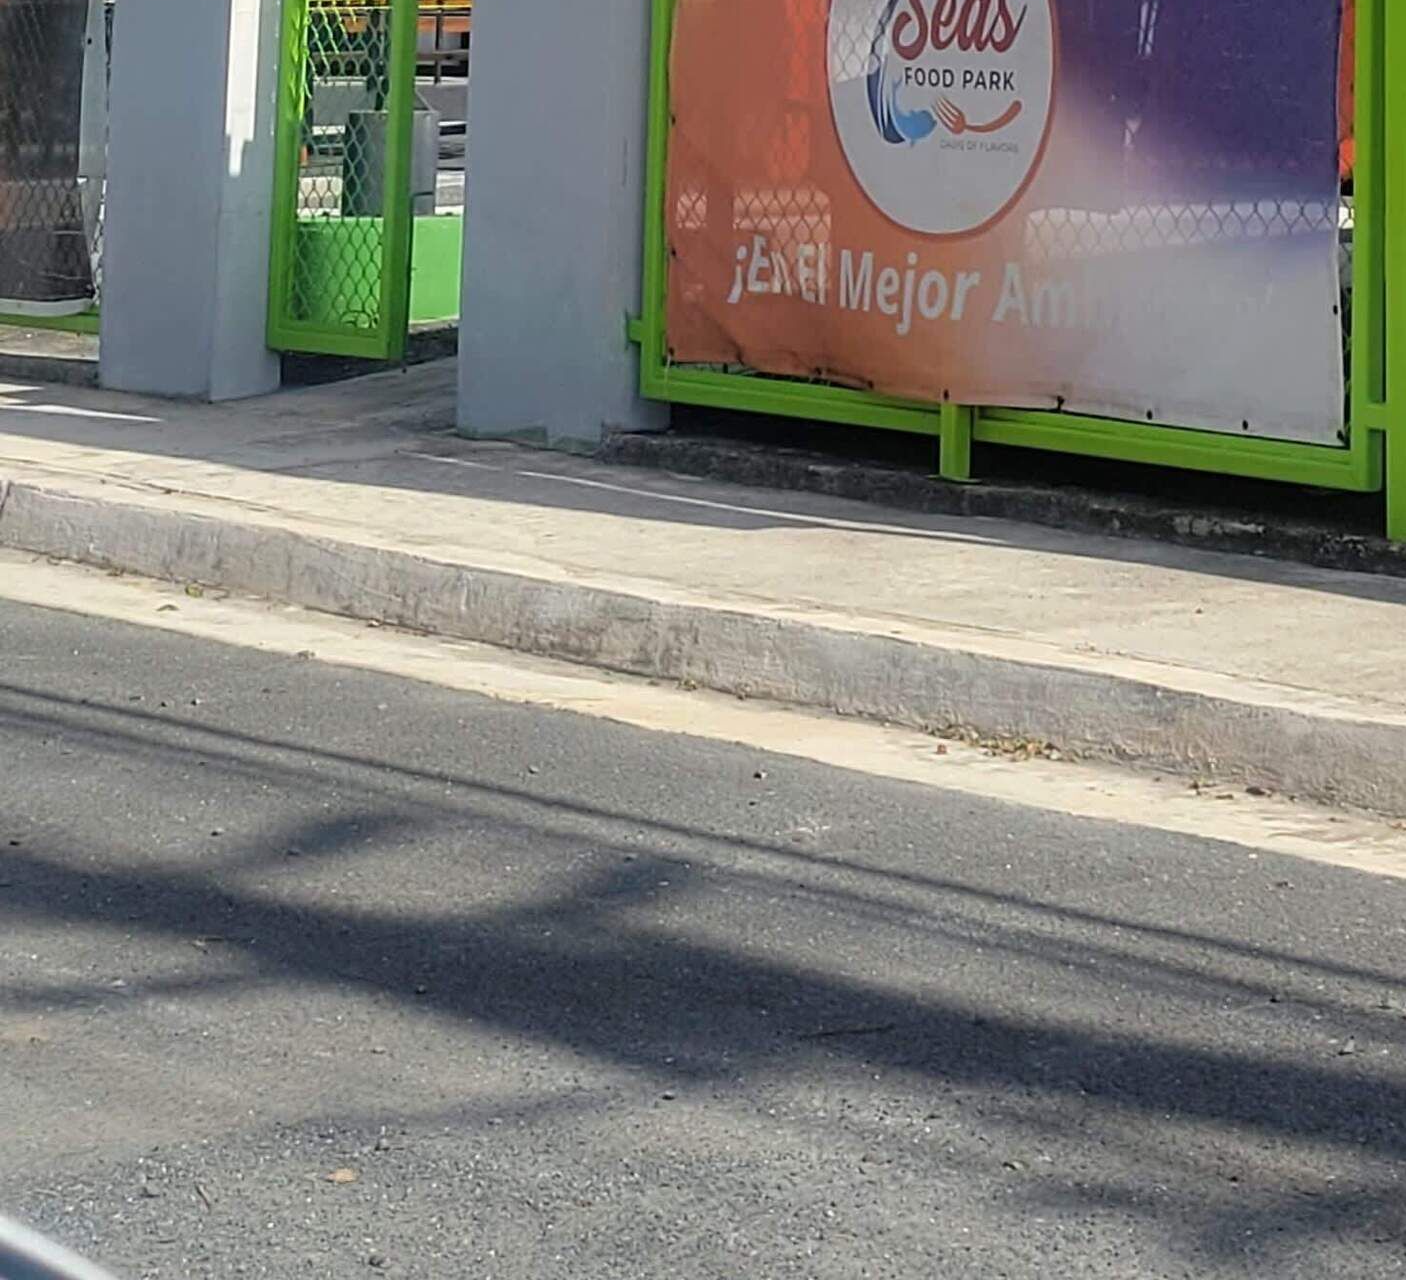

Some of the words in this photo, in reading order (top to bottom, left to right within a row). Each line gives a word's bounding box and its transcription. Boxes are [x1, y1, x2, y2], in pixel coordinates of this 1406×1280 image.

[905, 67, 954, 88] FOOD
[963, 70, 1015, 91] PARK
[839, 248, 981, 335] Mejor
